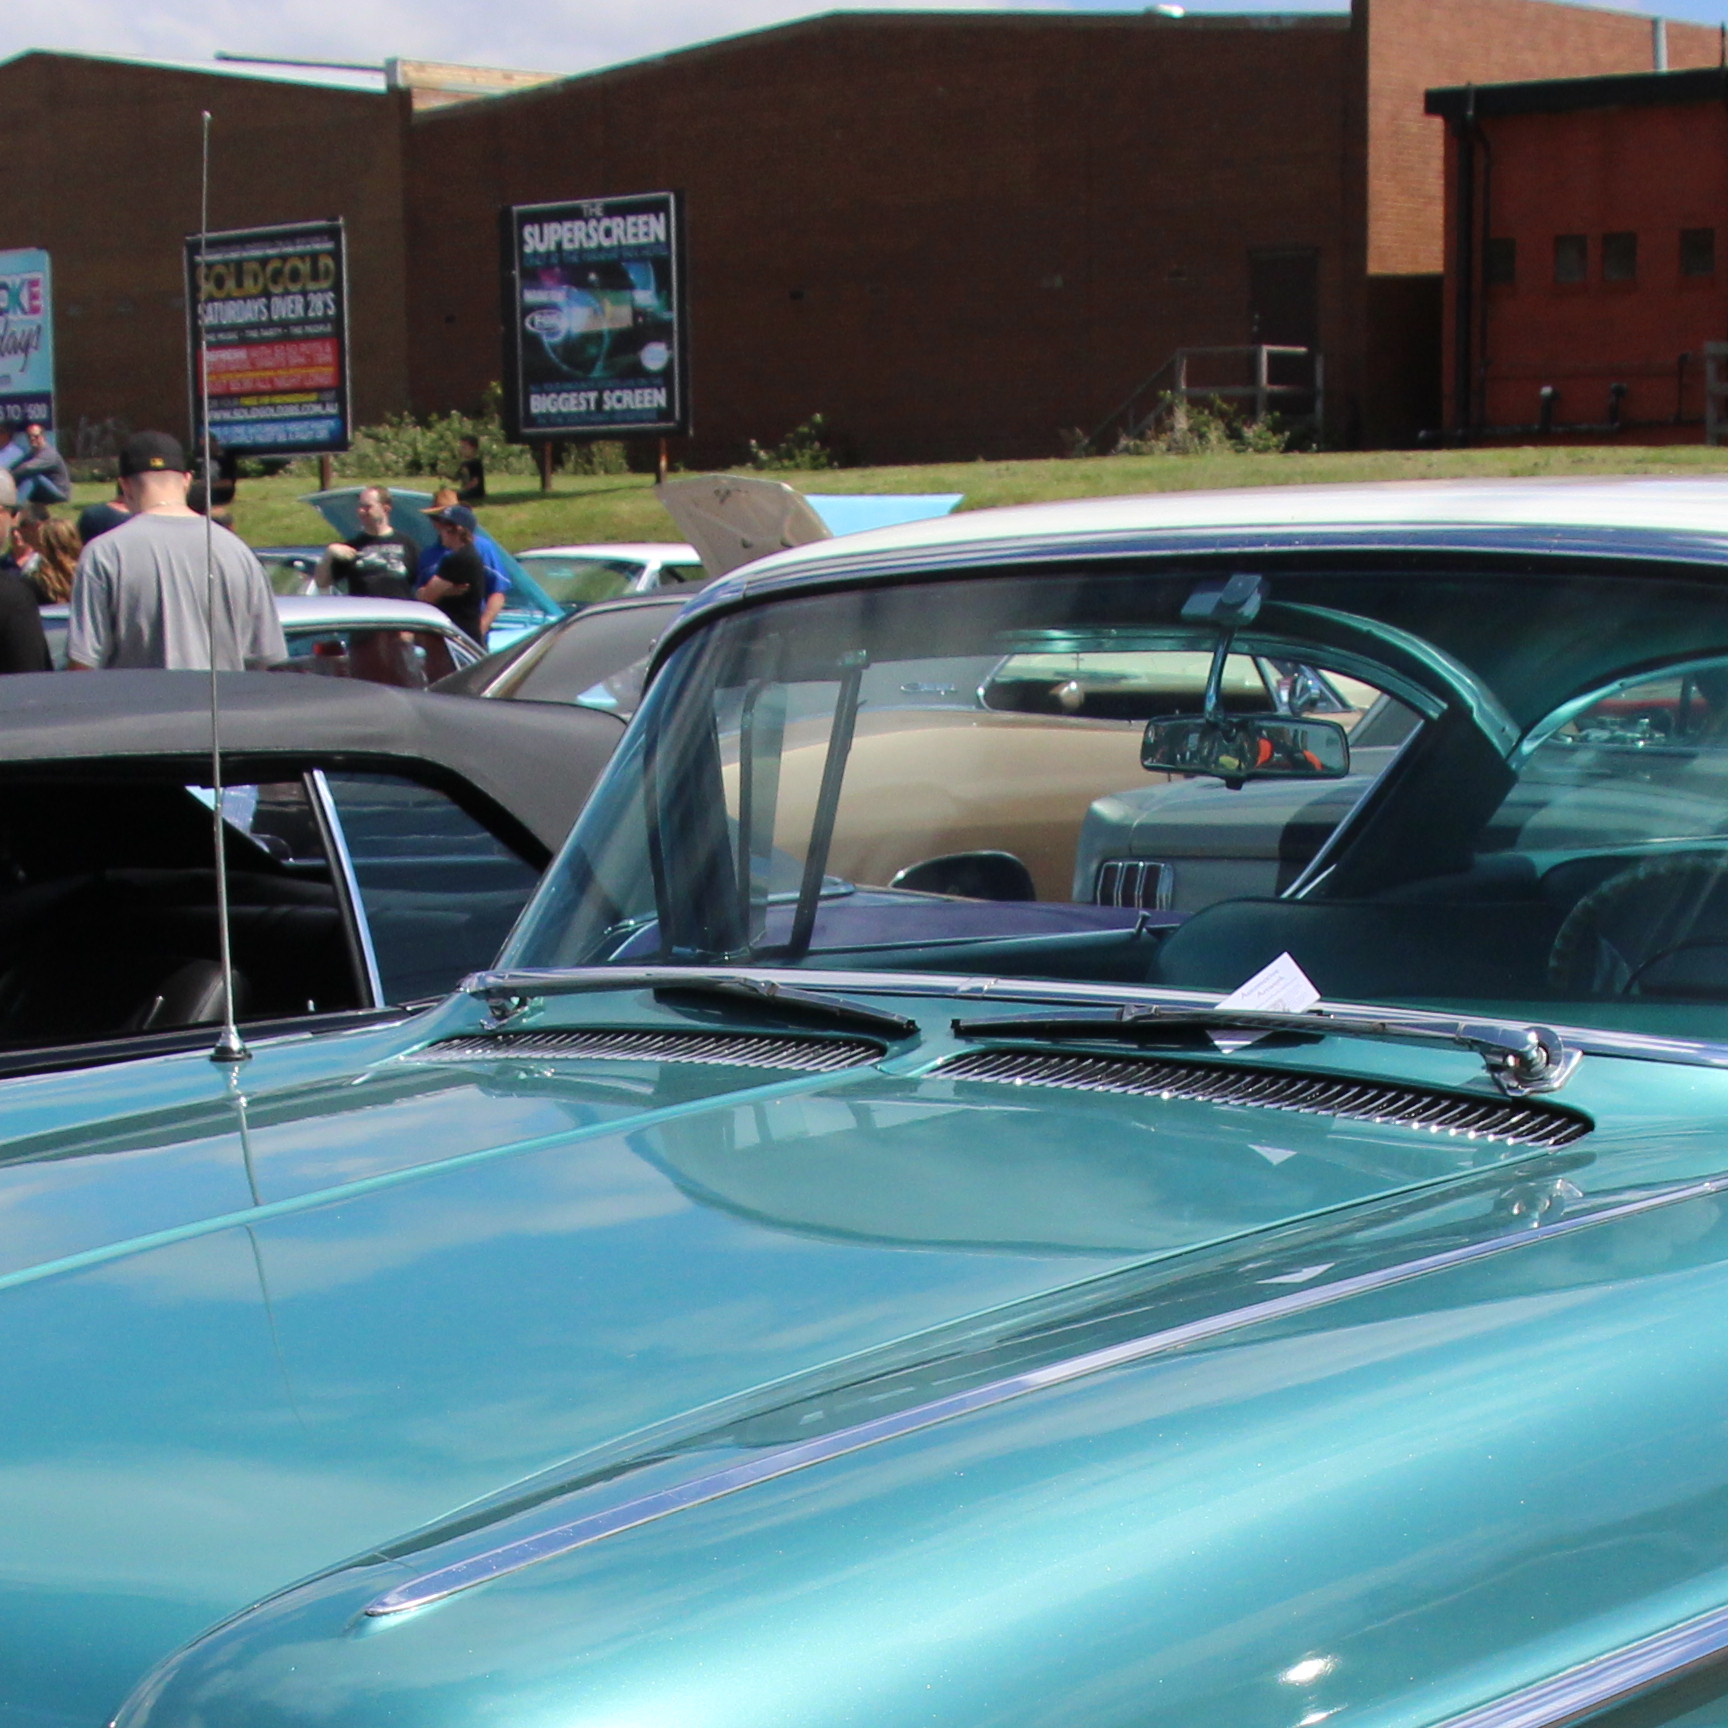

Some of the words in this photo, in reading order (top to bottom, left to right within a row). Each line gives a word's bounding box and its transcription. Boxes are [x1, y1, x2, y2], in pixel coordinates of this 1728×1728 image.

[583, 203, 604, 217] THE
[523, 212, 667, 253] SUPERSCREEN
[265, 253, 336, 294] GOLD
[197, 297, 268, 326] SATURDAYS
[270, 294, 305, 321] OVER
[530, 391, 599, 415] BIGGEST
[603, 387, 667, 411] SCREEN
